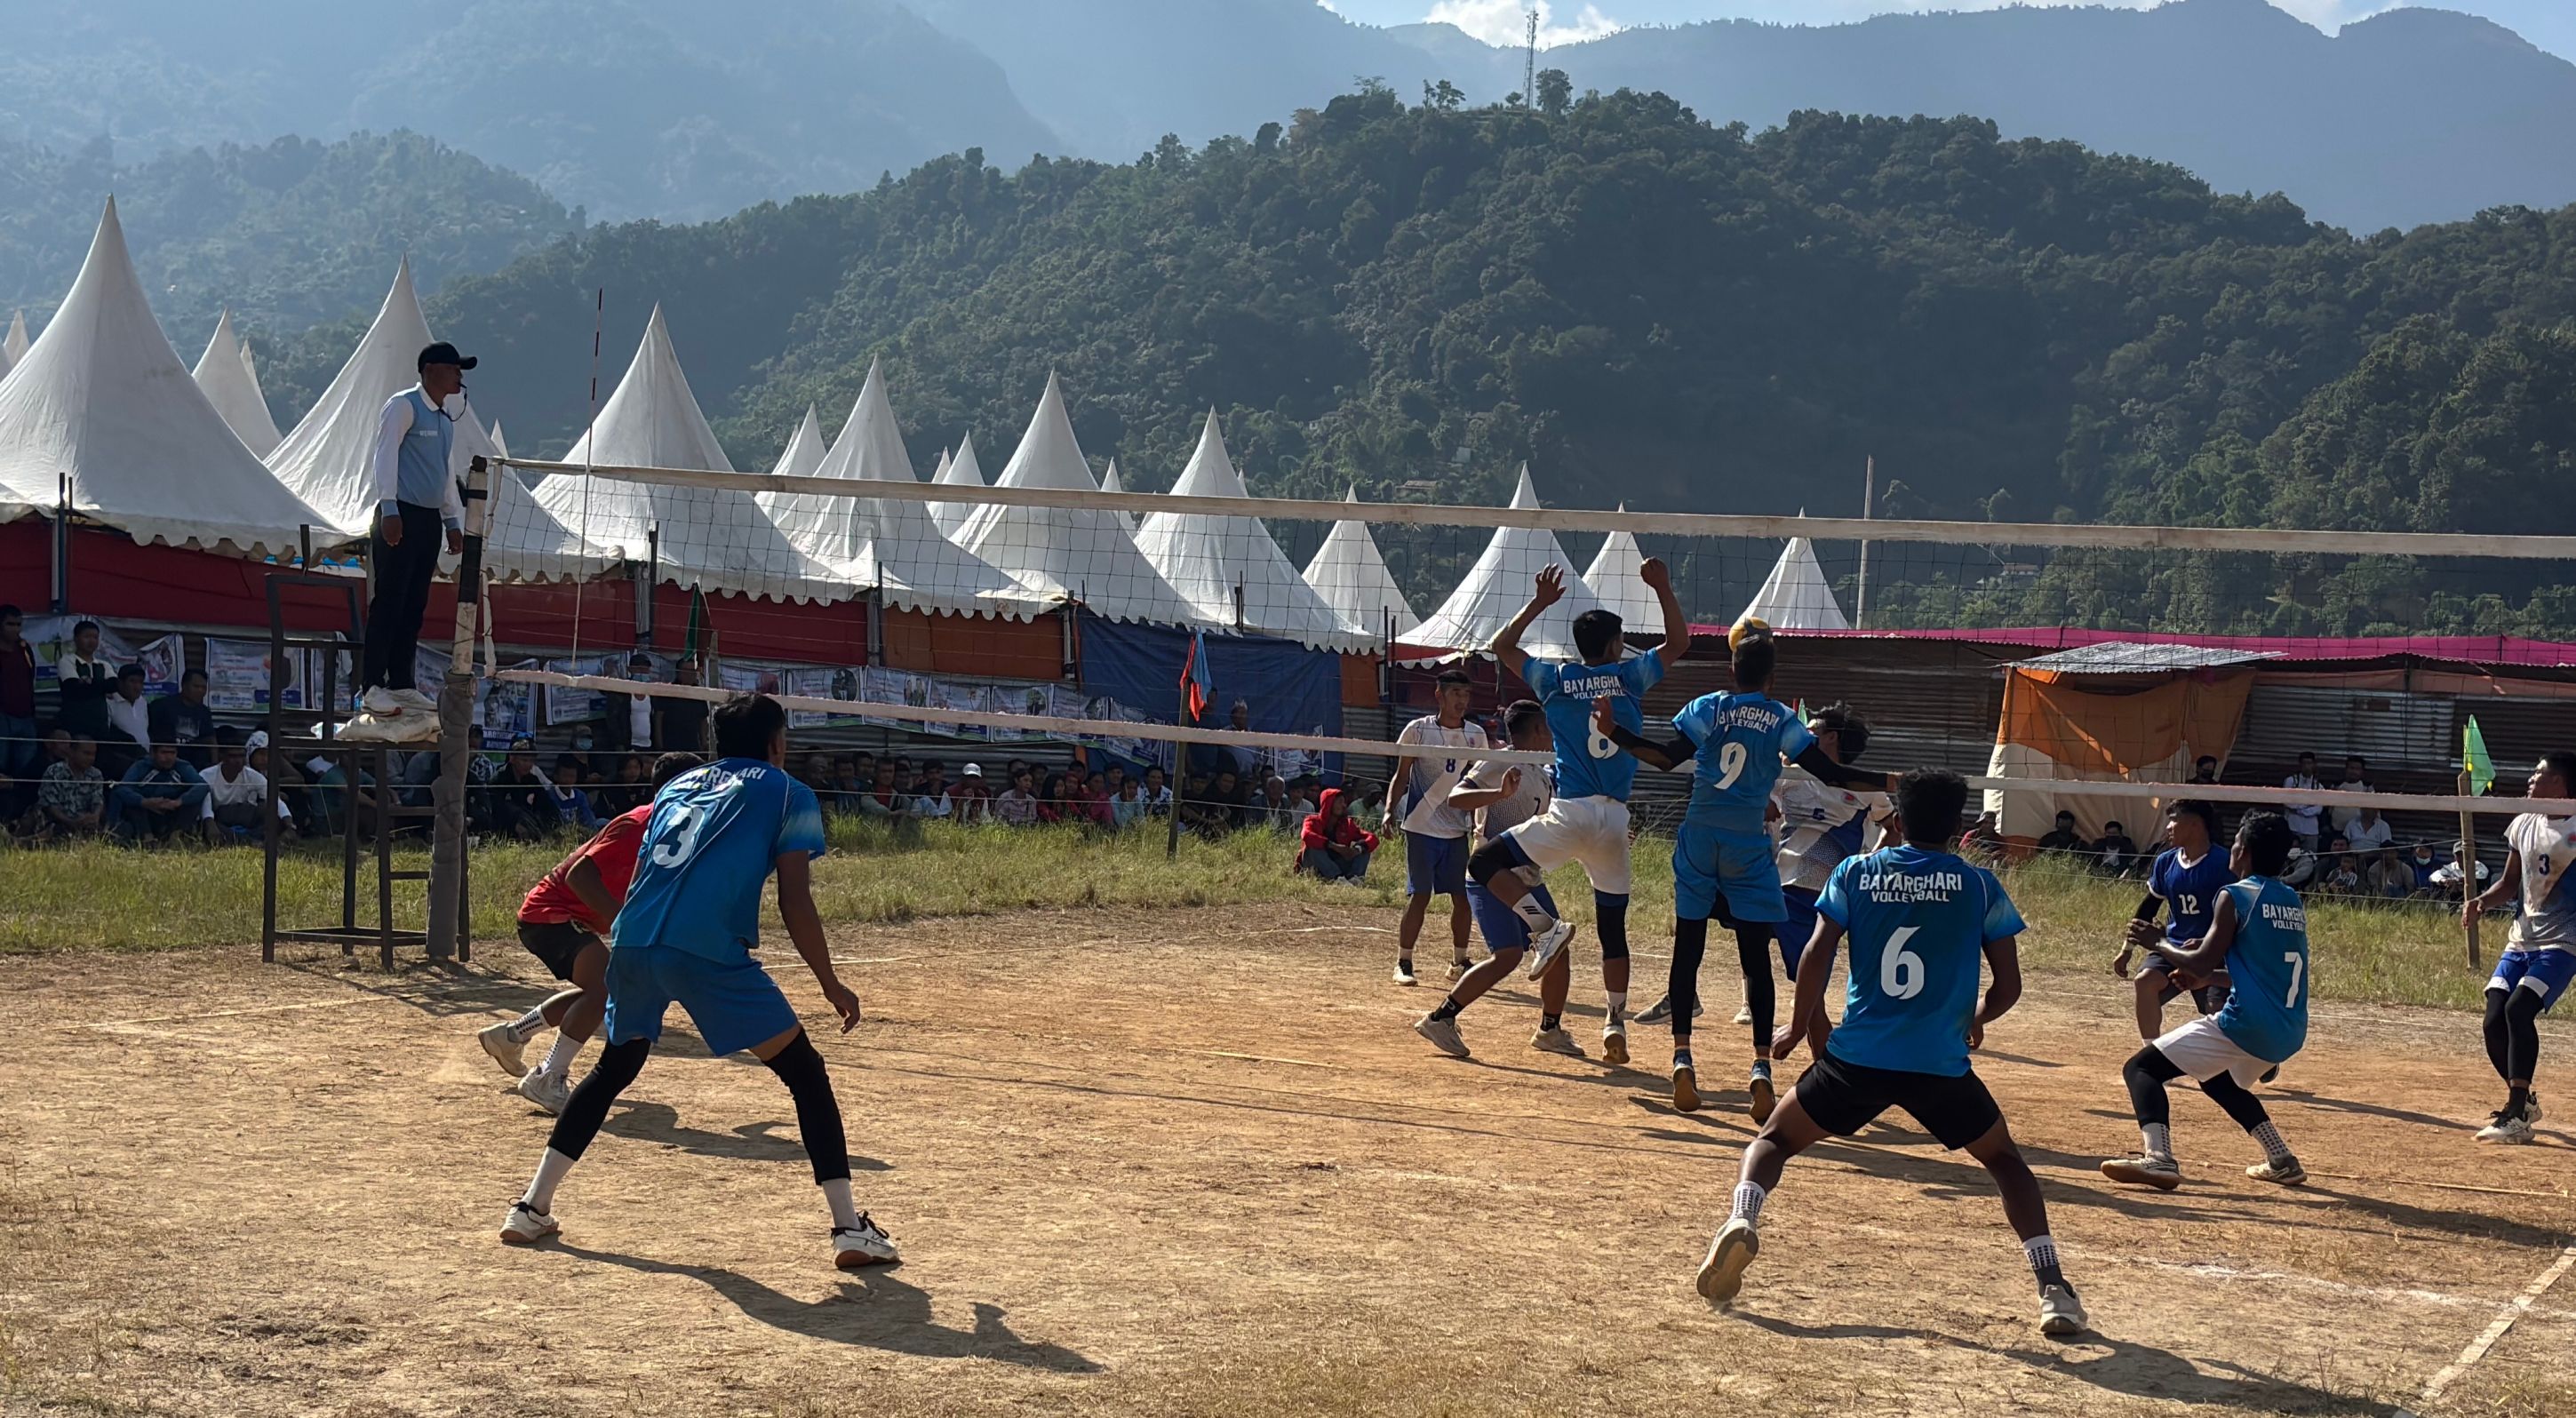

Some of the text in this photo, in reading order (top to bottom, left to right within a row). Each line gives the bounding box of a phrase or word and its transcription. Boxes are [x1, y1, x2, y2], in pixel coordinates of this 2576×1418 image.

[1713, 742, 1747, 790] 9
[653, 805, 704, 869] 3
[2539, 854, 2550, 875] 3
[1859, 872, 1962, 893] BAYARGHARI
[1871, 890, 1950, 903] VOLLEYBALL
[2179, 894, 2201, 915] 12
[1880, 926, 1925, 1000] 6
[2285, 952, 2303, 1008] 7
